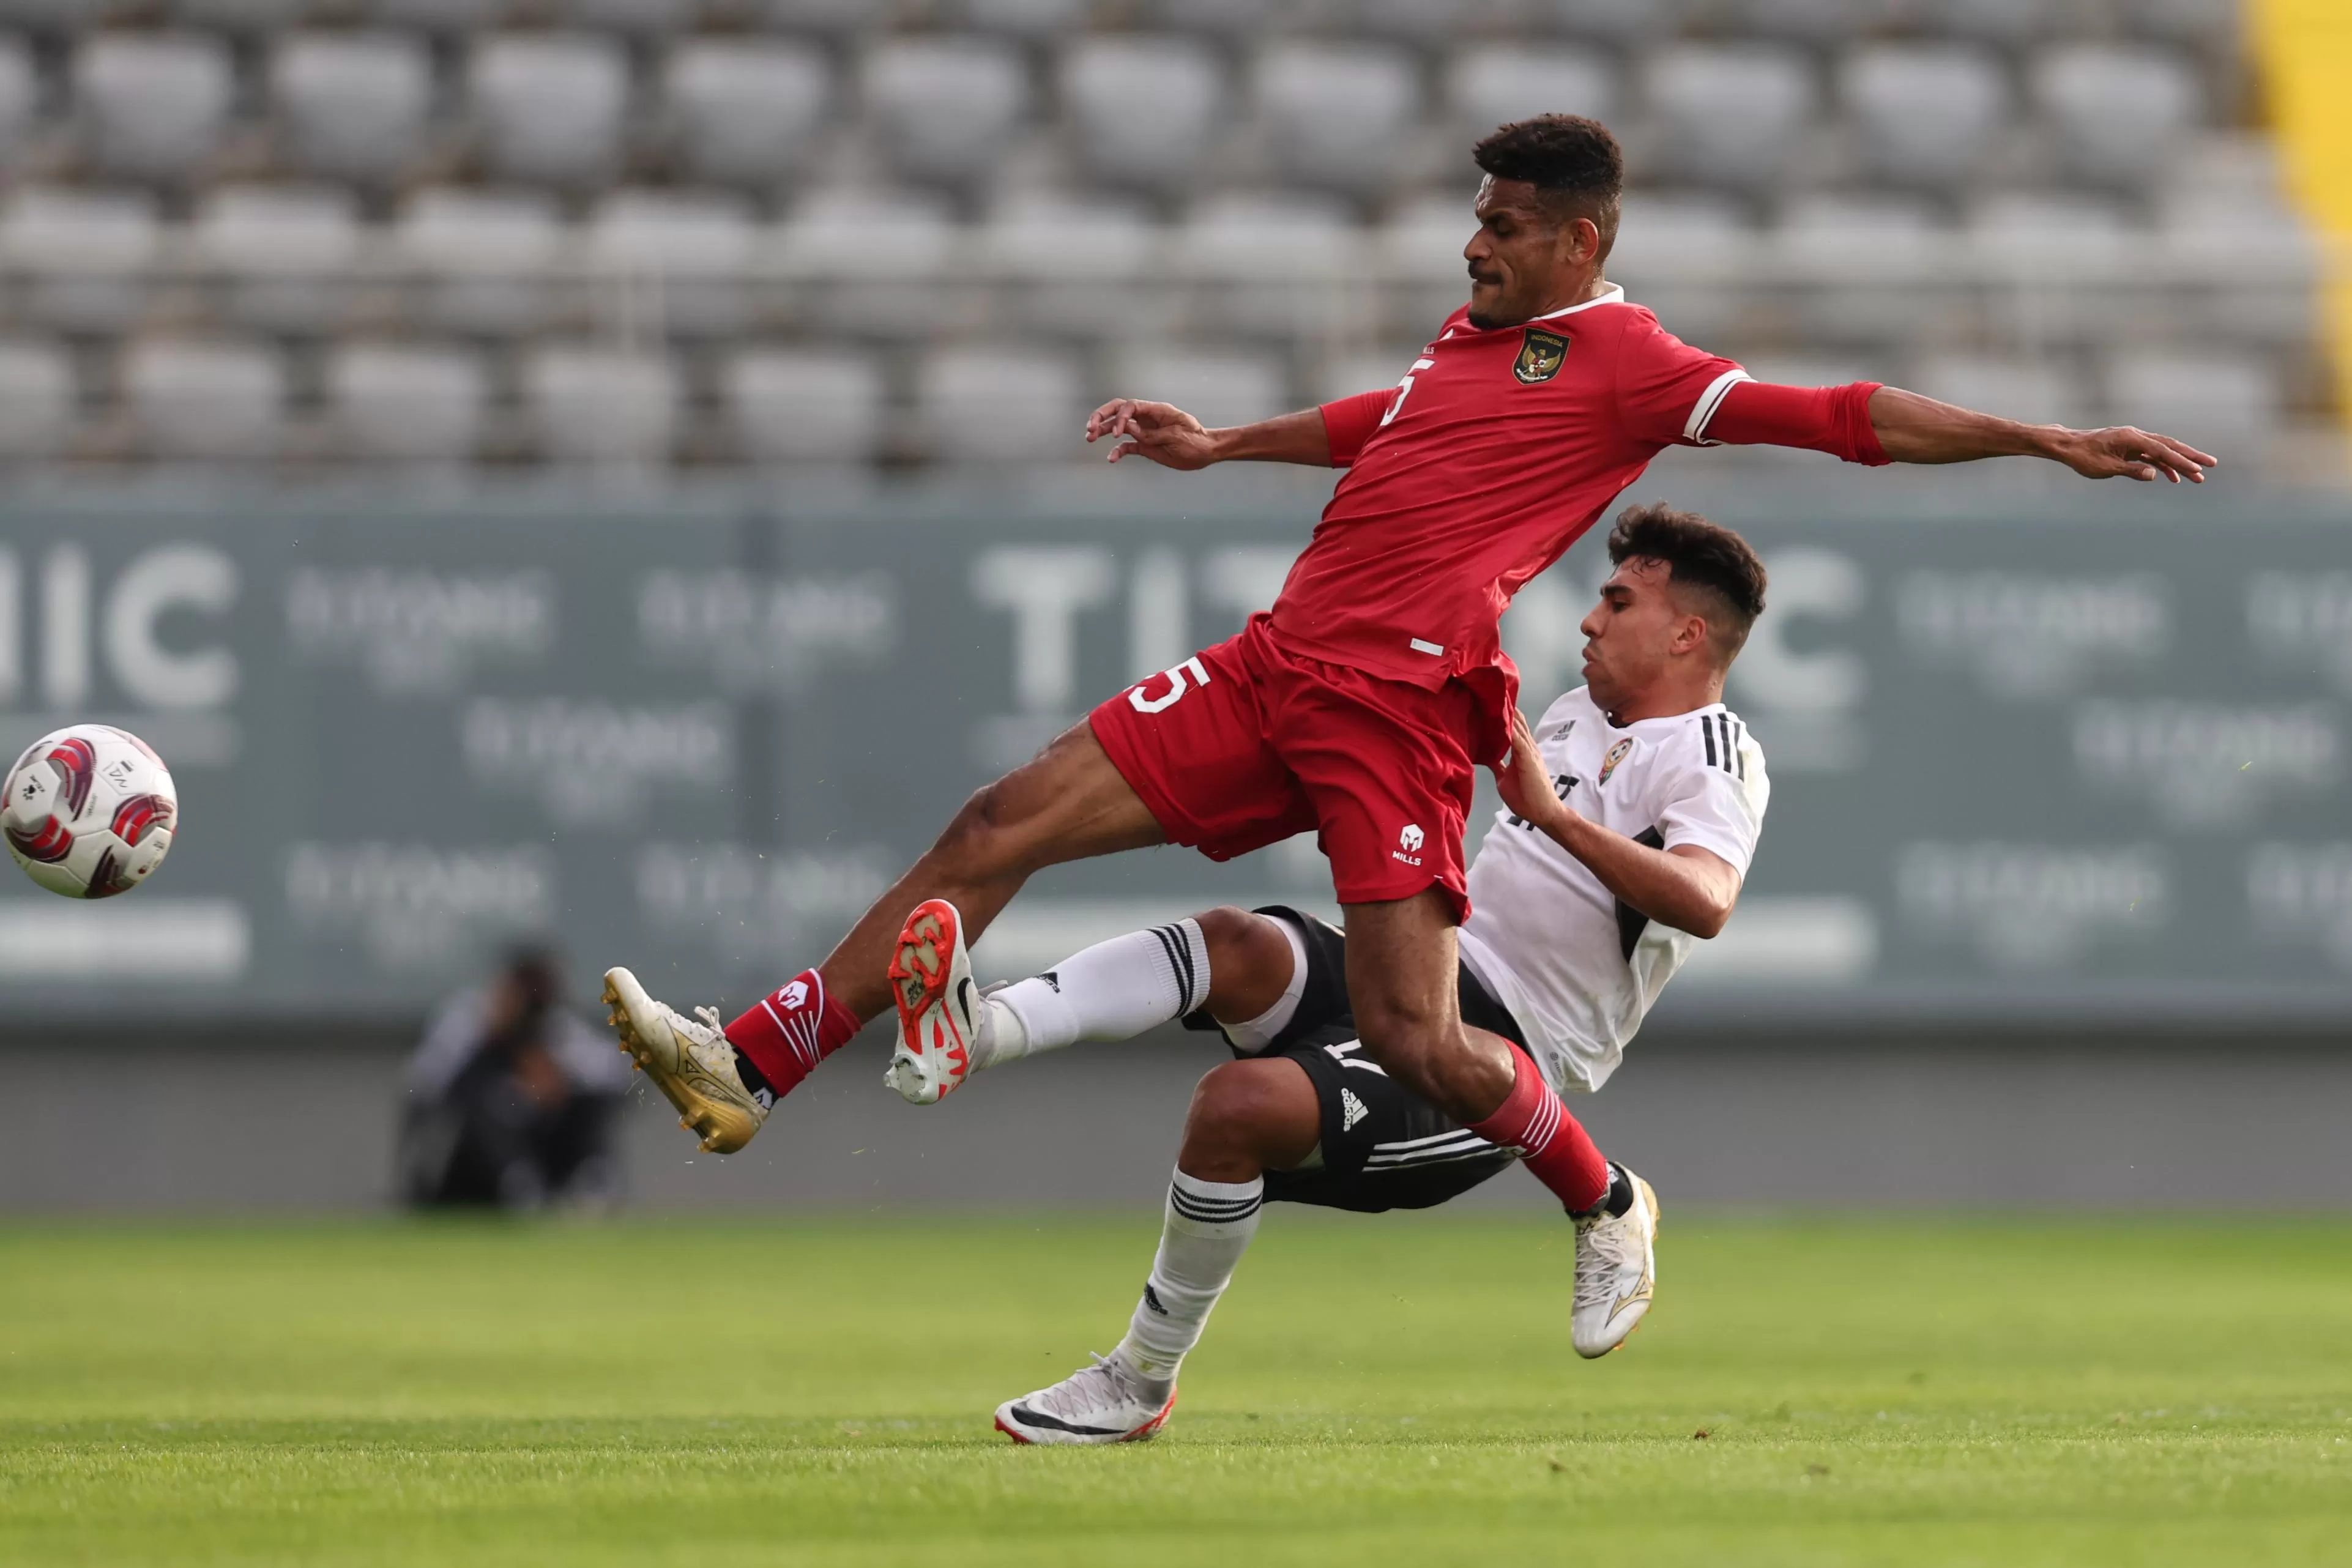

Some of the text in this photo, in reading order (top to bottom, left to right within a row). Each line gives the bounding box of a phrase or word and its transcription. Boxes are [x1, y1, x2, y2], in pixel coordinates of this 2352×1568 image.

[1531, 334, 1563, 348] INDONESIA
[0, 544, 241, 704] IC
[1123, 656, 1211, 713] 5
[1392, 850, 1421, 866] MILLS
[1341, 1087, 1353, 1132] adidas
